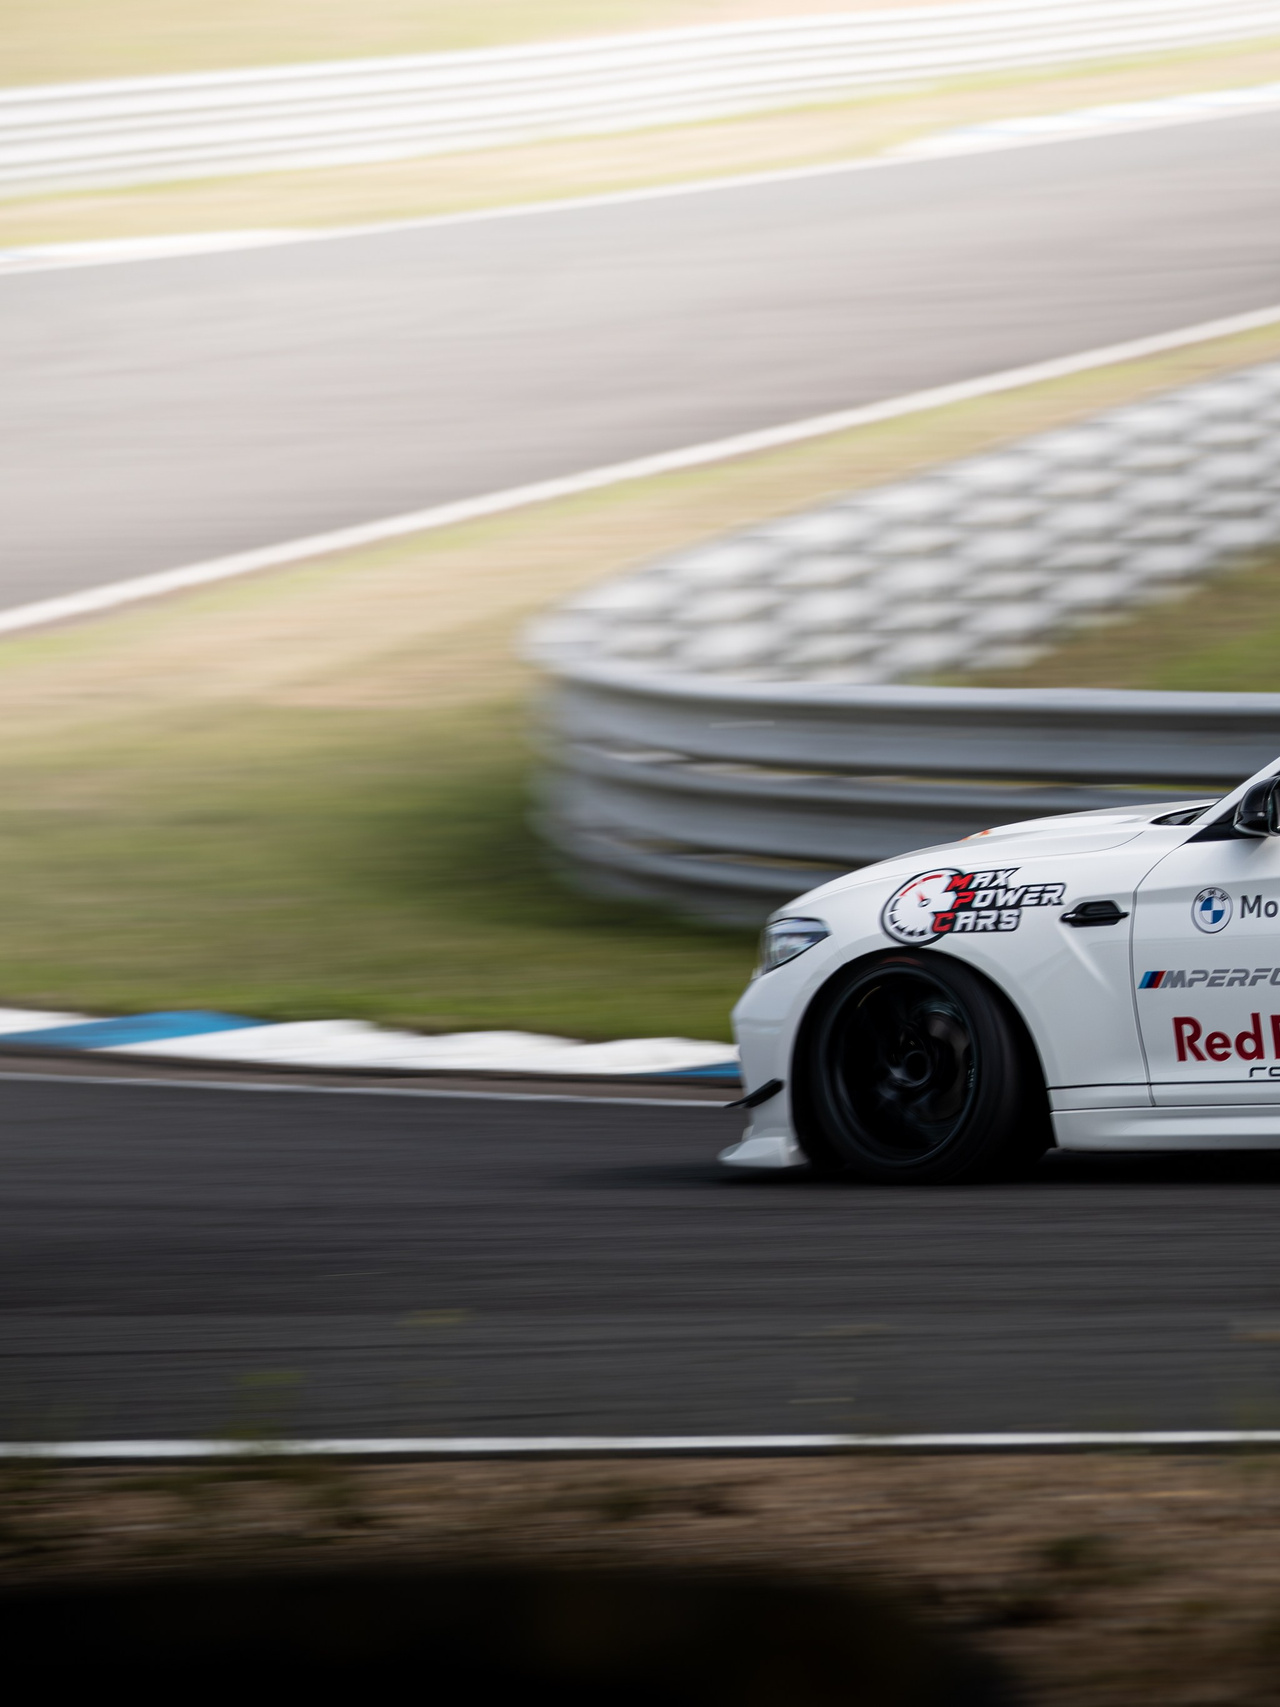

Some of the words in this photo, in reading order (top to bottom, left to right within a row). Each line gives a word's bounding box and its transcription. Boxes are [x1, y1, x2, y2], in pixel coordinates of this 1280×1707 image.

[945, 867, 1020, 892] MAX
[952, 883, 1065, 909] POWER
[932, 909, 1020, 932] CARS
[1172, 1012, 1265, 1062] Red
